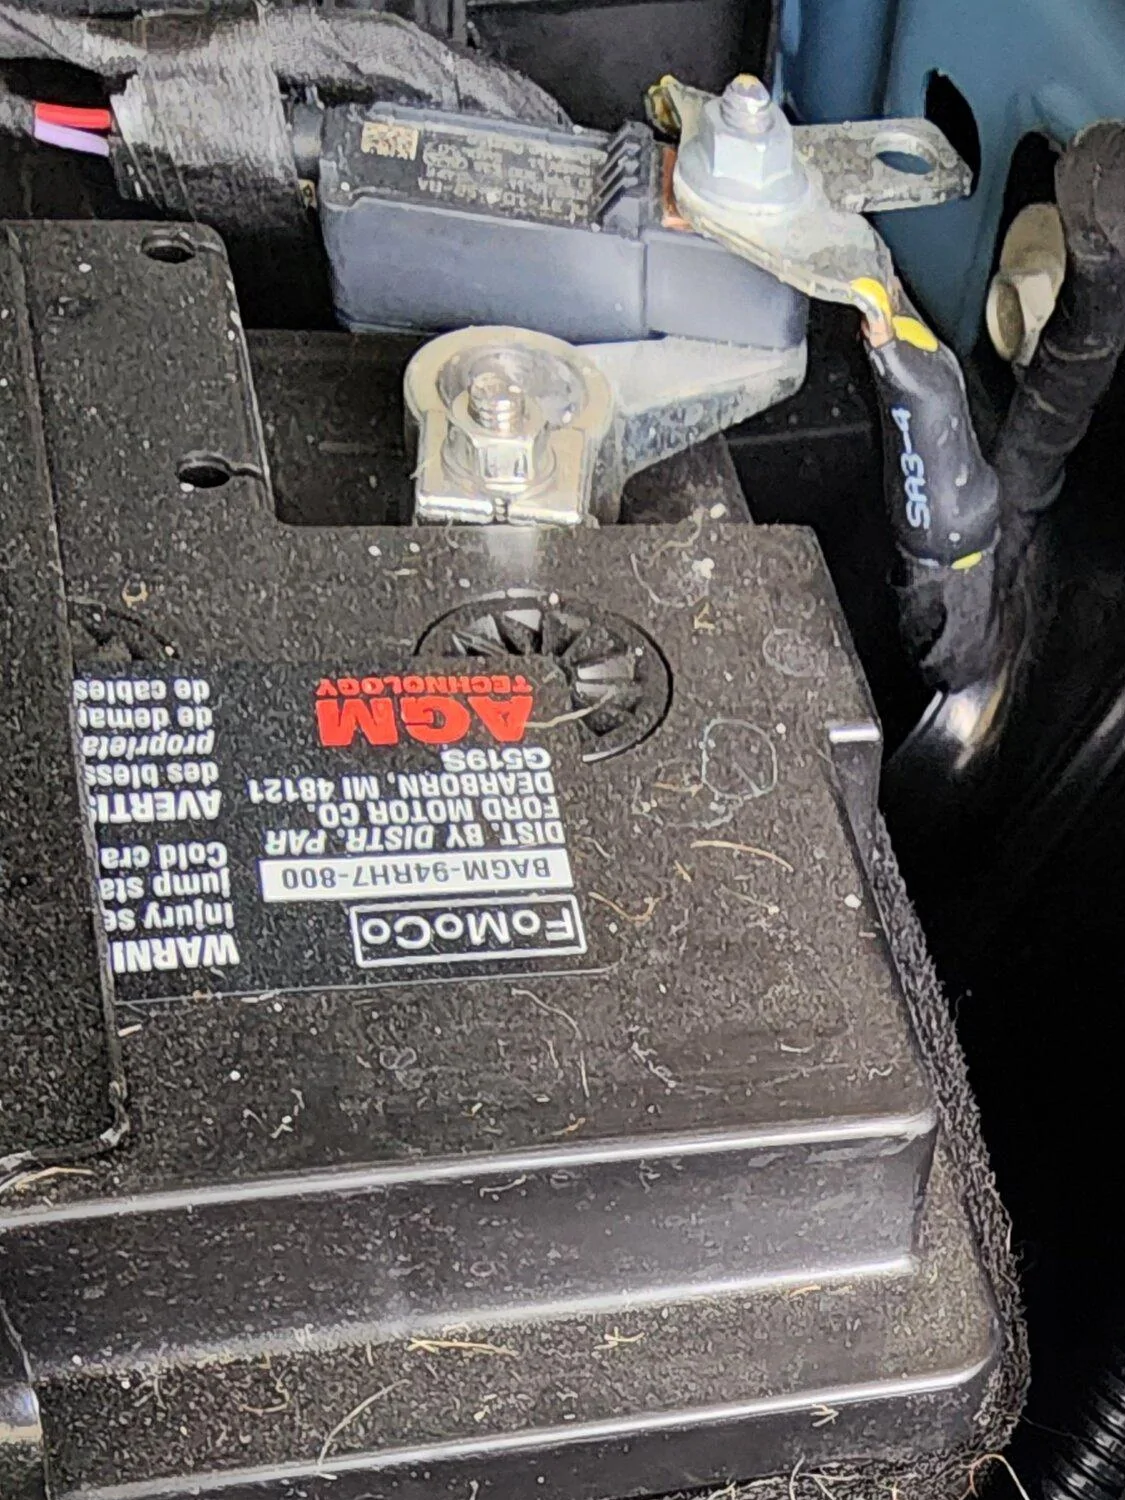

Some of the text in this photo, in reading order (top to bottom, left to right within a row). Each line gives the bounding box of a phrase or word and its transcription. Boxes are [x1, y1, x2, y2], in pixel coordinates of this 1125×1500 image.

[891, 407, 930, 530] SA3-4
[173, 678, 211, 704] de
[316, 675, 533, 696] TECHNOLOGY
[177, 705, 213, 730] de
[316, 696, 533, 746] AGM
[166, 761, 219, 787] des
[440, 747, 551, 772] G519S
[248, 771, 555, 804] DEARBORN, MI 48121
[307, 796, 560, 828] FORD MOTOR CO.
[264, 820, 566, 856] DIST. BY DISTR. PAR
[101, 841, 228, 870] Cold cra
[153, 867, 231, 898] jump
[281, 856, 551, 889] BAGM-94RH7-800
[144, 899, 235, 930] injury
[361, 907, 575, 949] FoMoCo
